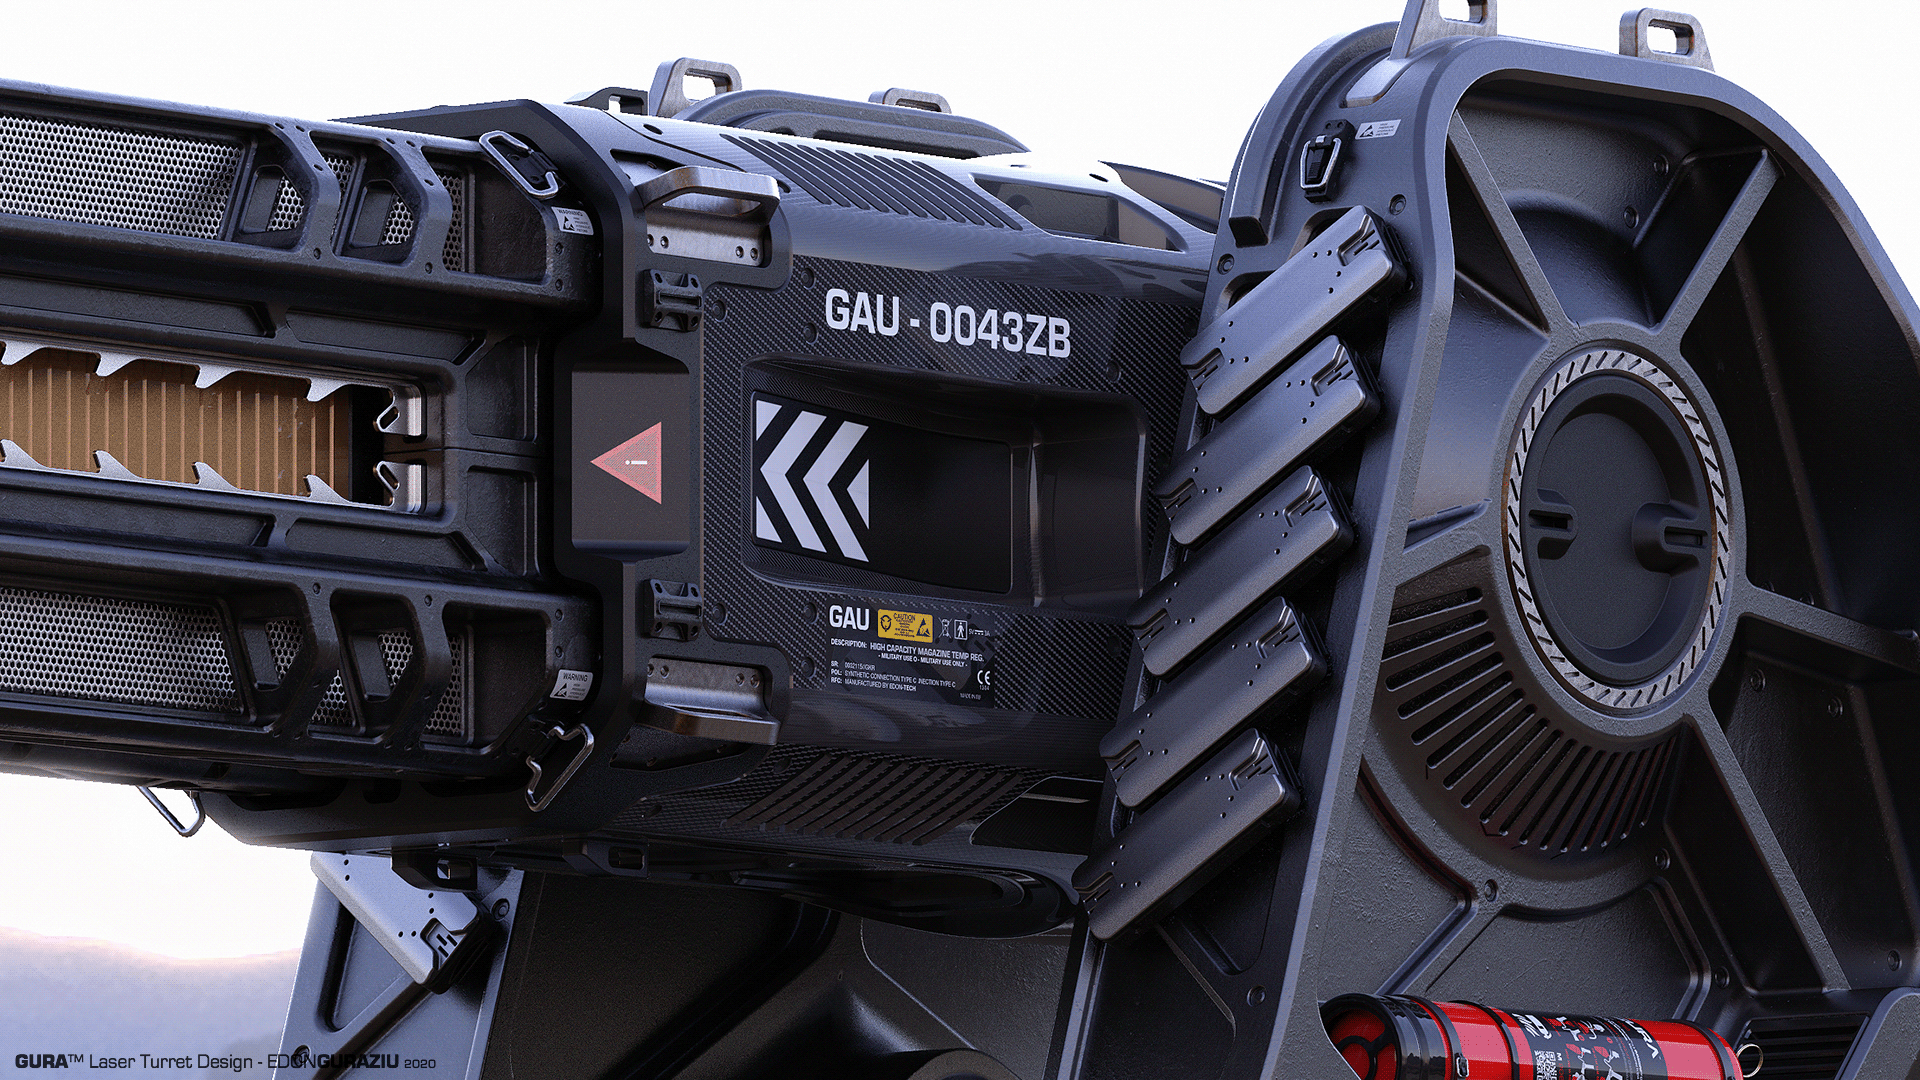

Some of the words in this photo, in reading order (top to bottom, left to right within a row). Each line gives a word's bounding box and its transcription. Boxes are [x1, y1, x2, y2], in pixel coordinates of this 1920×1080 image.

[825, 288, 900, 337] GAU
[910, 318, 920, 328] -
[930, 302, 1071, 358] 0043ZB
[829, 605, 870, 631] GAU
[831, 638, 867, 649] DESCRIPTION:
[870, 642, 885, 651] HIGH
[886, 644, 917, 654] CAPACITY
[918, 647, 951, 658] MAGAZINE
[952, 650, 969, 660] TEMP
[970, 653, 985, 662] REG.
[881, 652, 902, 661] MILITARY
[920, 657, 943, 665] MILITARY
[952, 660, 965, 668] ONLY
[563, 672, 588, 682] WARNING
[870, 672, 901, 682] CONNECTION
[901, 675, 913, 683] TYPE
[940, 680, 952, 688] TYPE
